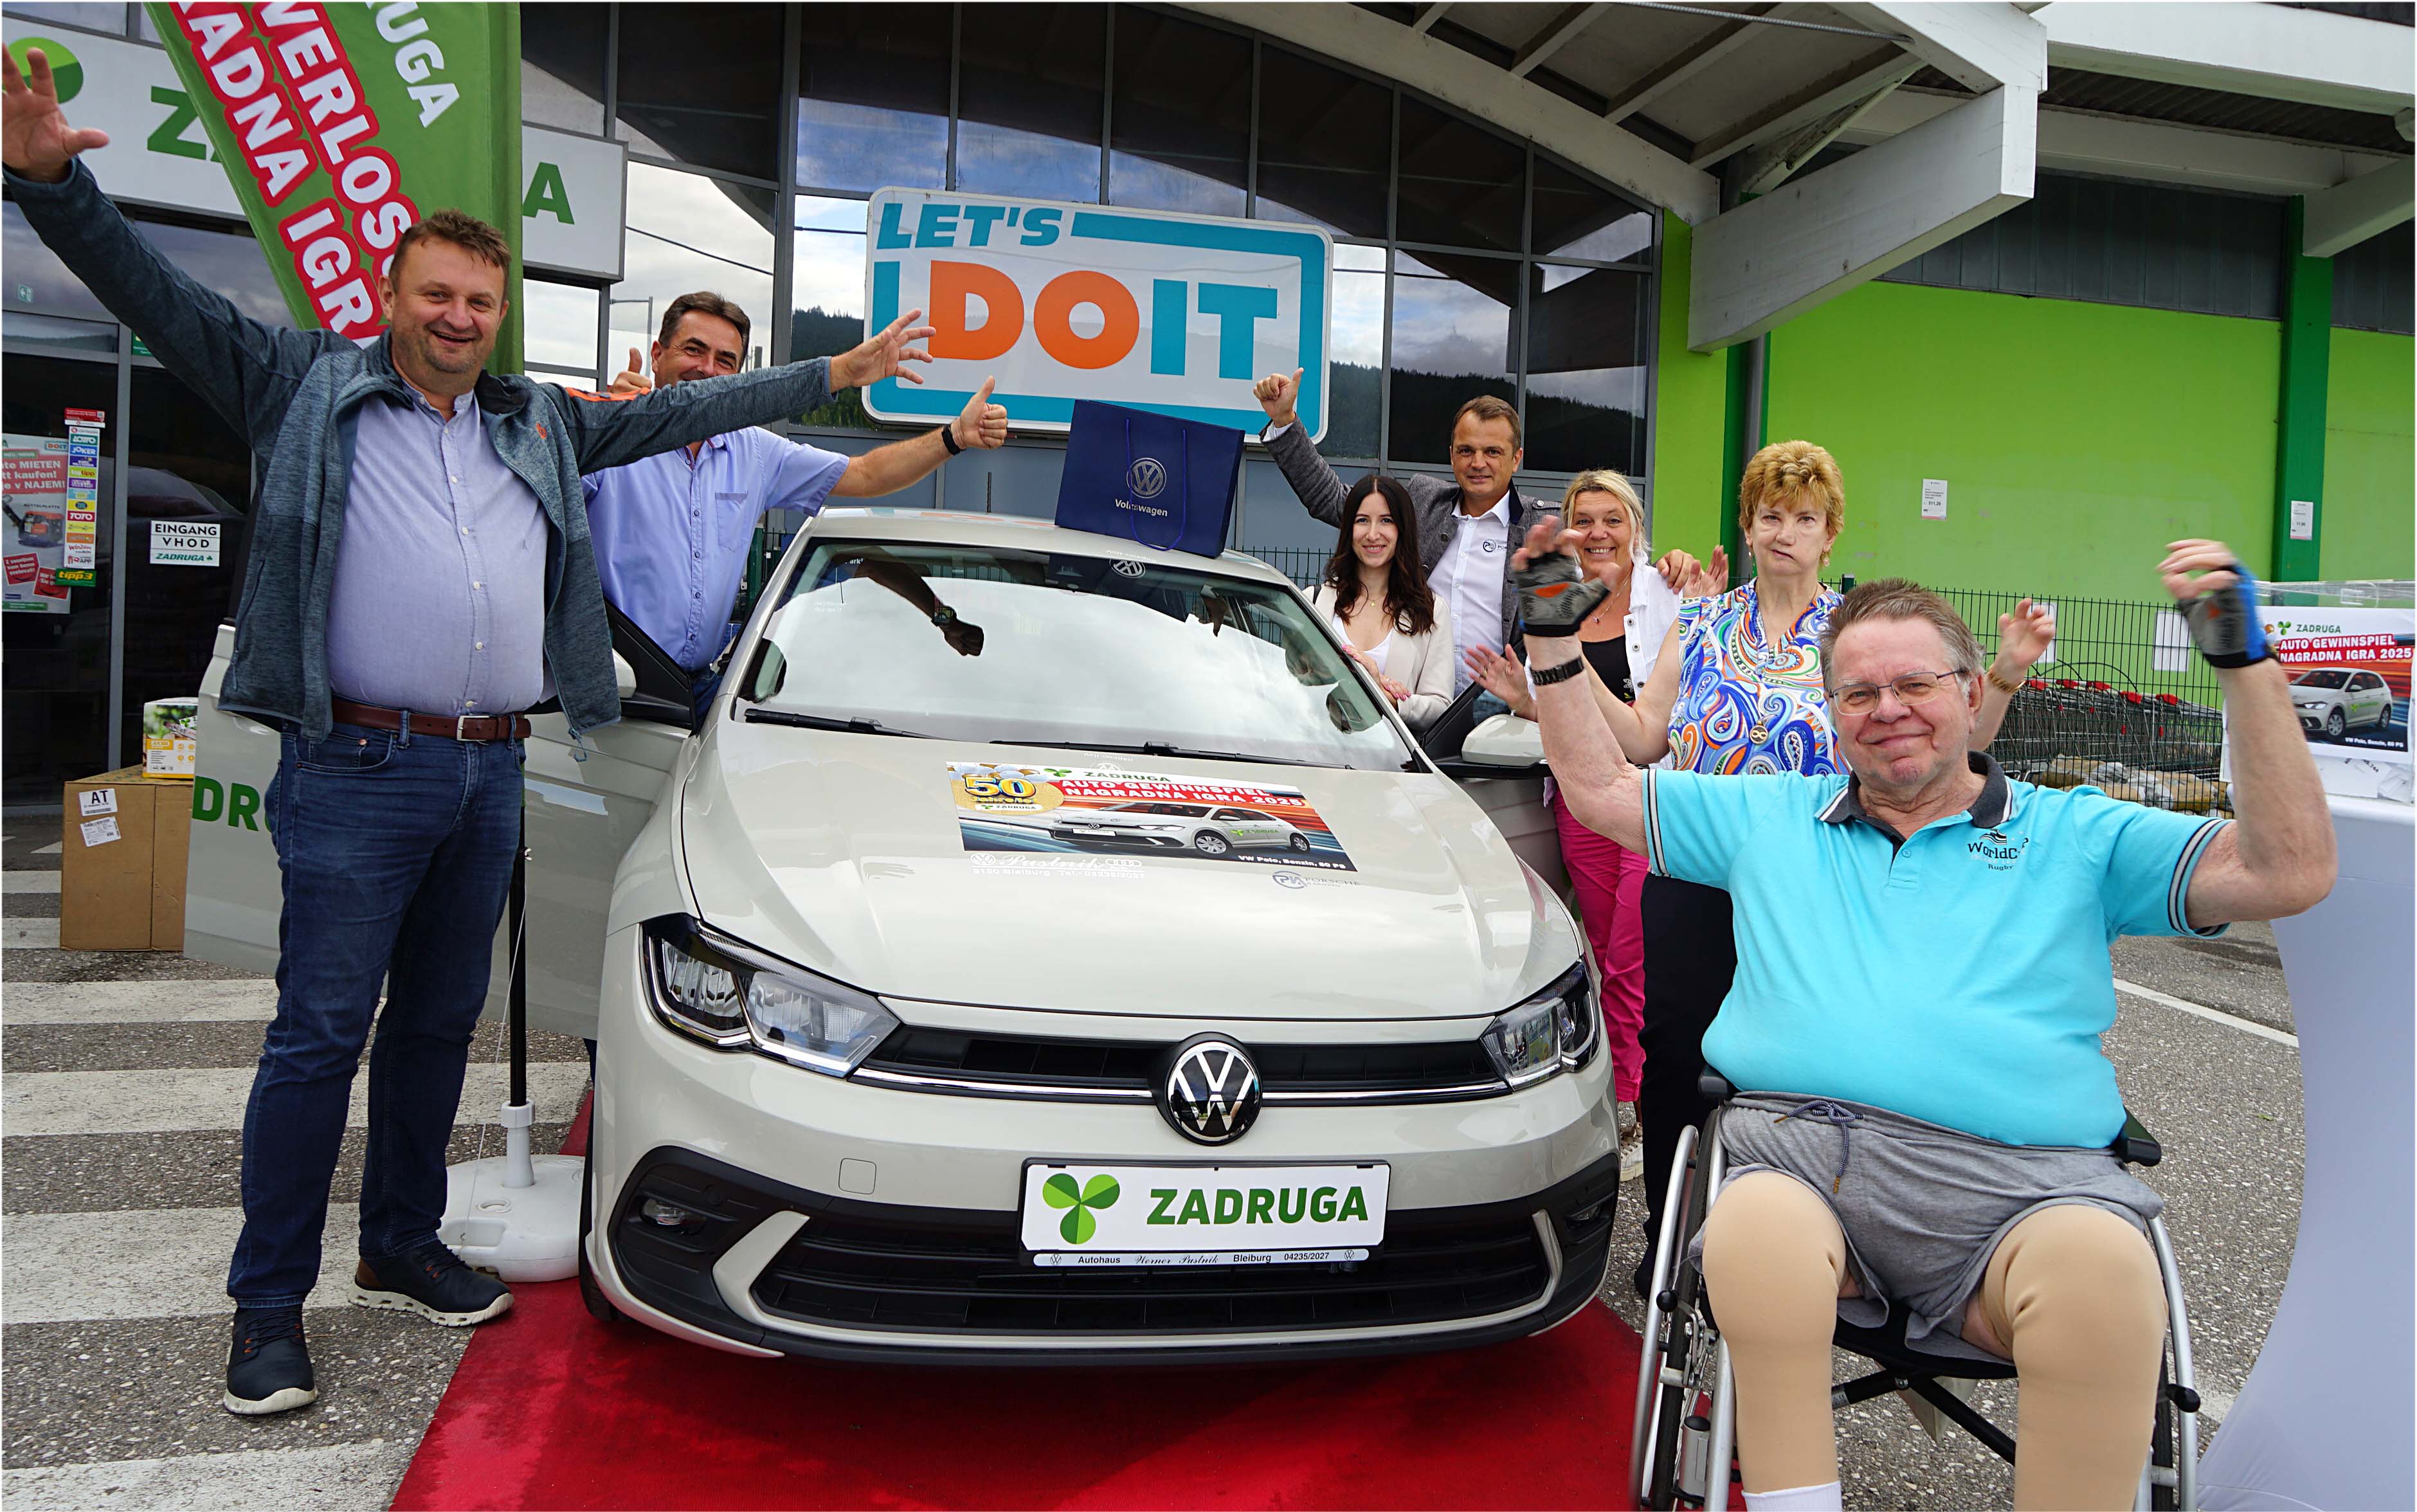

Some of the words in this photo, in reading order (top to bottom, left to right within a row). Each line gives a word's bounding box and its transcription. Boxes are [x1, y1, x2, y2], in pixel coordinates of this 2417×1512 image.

[364, 2, 460, 128] UGA
[260, 2, 412, 278] VERLOS
[177, 2, 309, 197] ADNA
[287, 207, 381, 351] IGR
[876, 203, 1062, 249] LET'S
[71, 446, 96, 455] JOKER
[19, 460, 61, 469] MIETEN
[14, 470, 57, 479] kaufen!
[24, 480, 66, 489] NAJEM!
[69, 512, 93, 521] TOTO
[155, 523, 217, 536] EINGANG
[162, 537, 210, 548] VHOD
[156, 553, 204, 561] ZADRUGA
[2295, 624, 2341, 633] ZADRUGA
[2280, 639, 2308, 651] AUTO
[2313, 634, 2395, 649] GEWINNSPIEL
[2280, 650, 2342, 663] NAGRADNA
[2346, 649, 2376, 660] IGRA
[2380, 647, 2412, 659] 2025
[1083, 771, 1172, 782] ZADRUGA
[964, 777, 1036, 798] 50
[1062, 780, 1116, 789] AUTO
[1123, 782, 1269, 797] GEWINNSPIEL
[91, 789, 109, 804] AT
[1066, 788, 1188, 800] NAGRADNA
[1193, 793, 1247, 802] IGRA
[1251, 796, 1303, 806] 2025
[192, 775, 273, 834] DR
[1146, 1186, 1369, 1225] ZADRUGA
[1078, 1256, 1121, 1264] Autohaus
[1233, 1254, 1271, 1264] Bleiburg
[1284, 1252, 1329, 1261] 04235/2027
